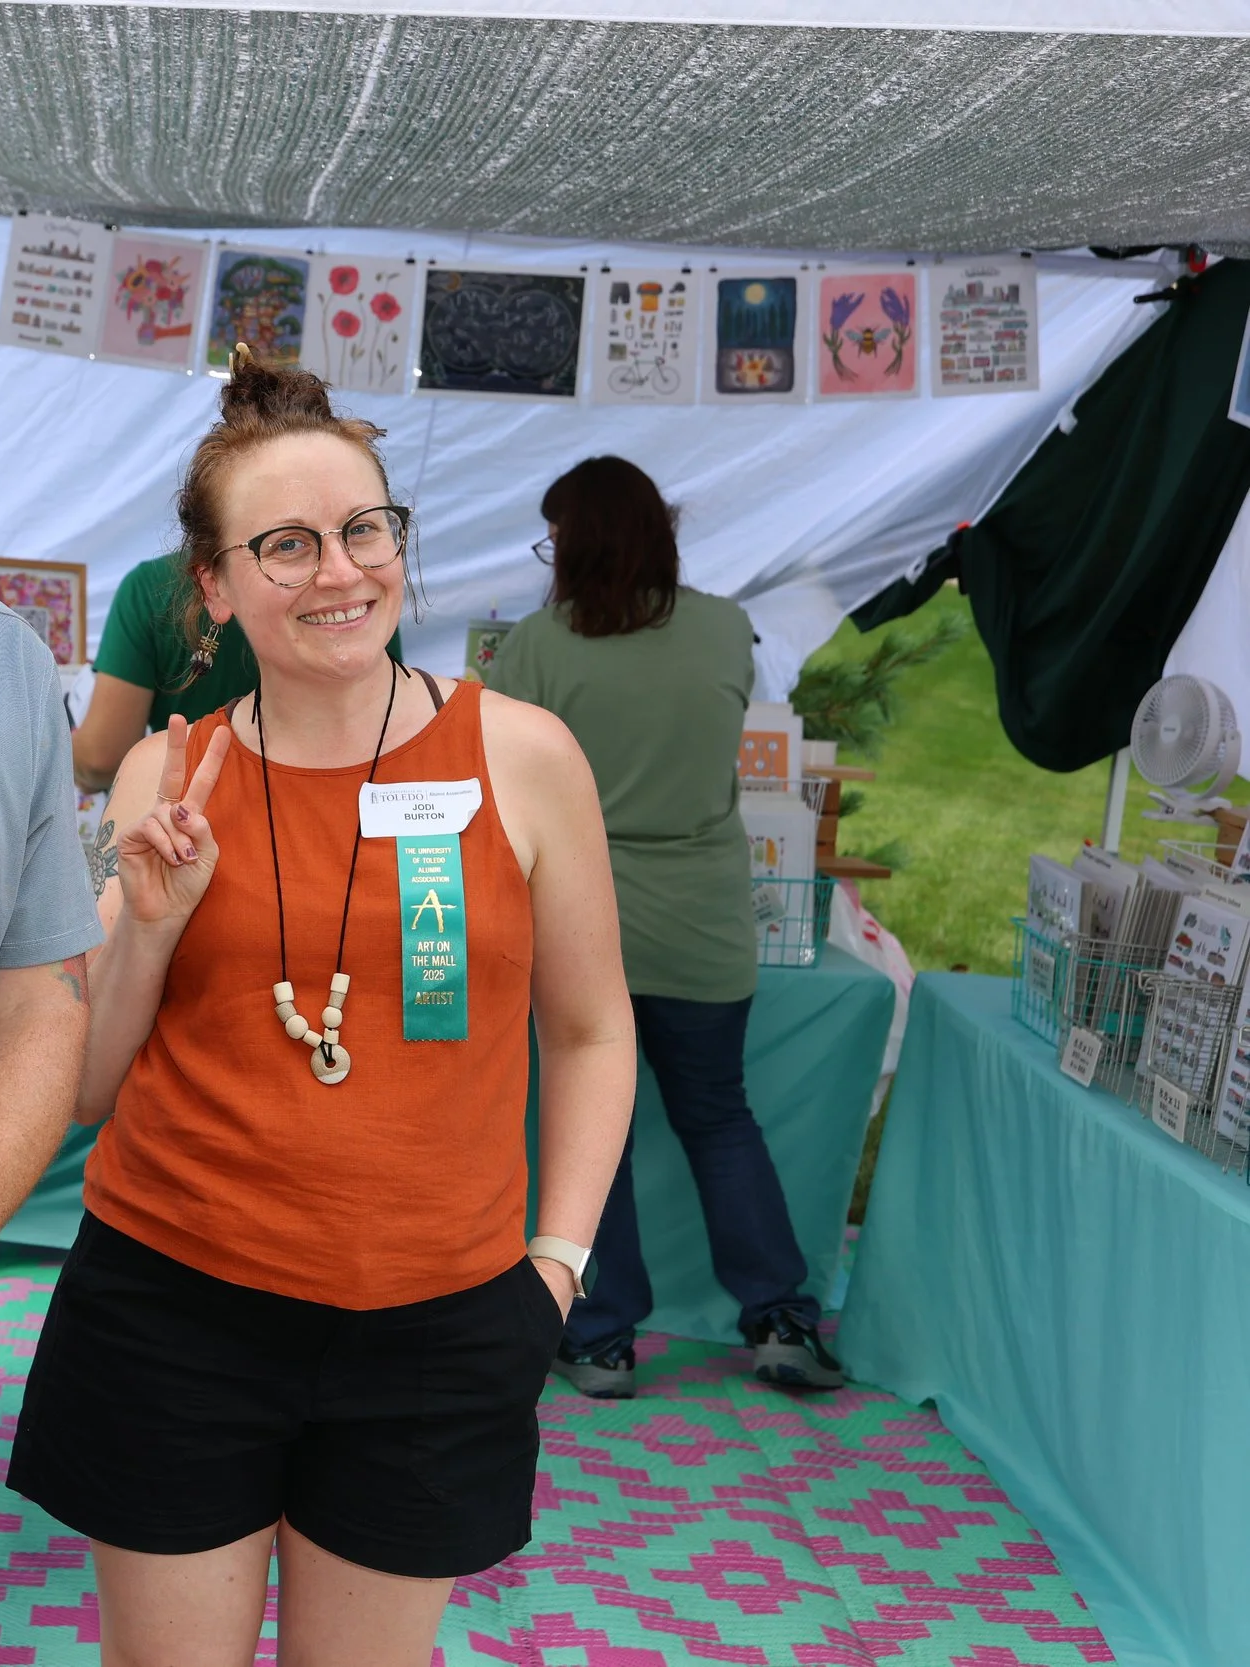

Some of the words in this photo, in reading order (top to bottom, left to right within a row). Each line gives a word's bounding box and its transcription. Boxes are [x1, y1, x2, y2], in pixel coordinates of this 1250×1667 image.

[380, 793, 424, 803] TOLEDO
[412, 803, 435, 811] JODI
[404, 812, 445, 820] BURTON
[417, 941, 435, 952] ART
[437, 941, 451, 952] ON
[411, 955, 429, 966] THE
[432, 955, 456, 966] MALL
[422, 969, 445, 980] 2025
[414, 991, 454, 1005] ARTIST
